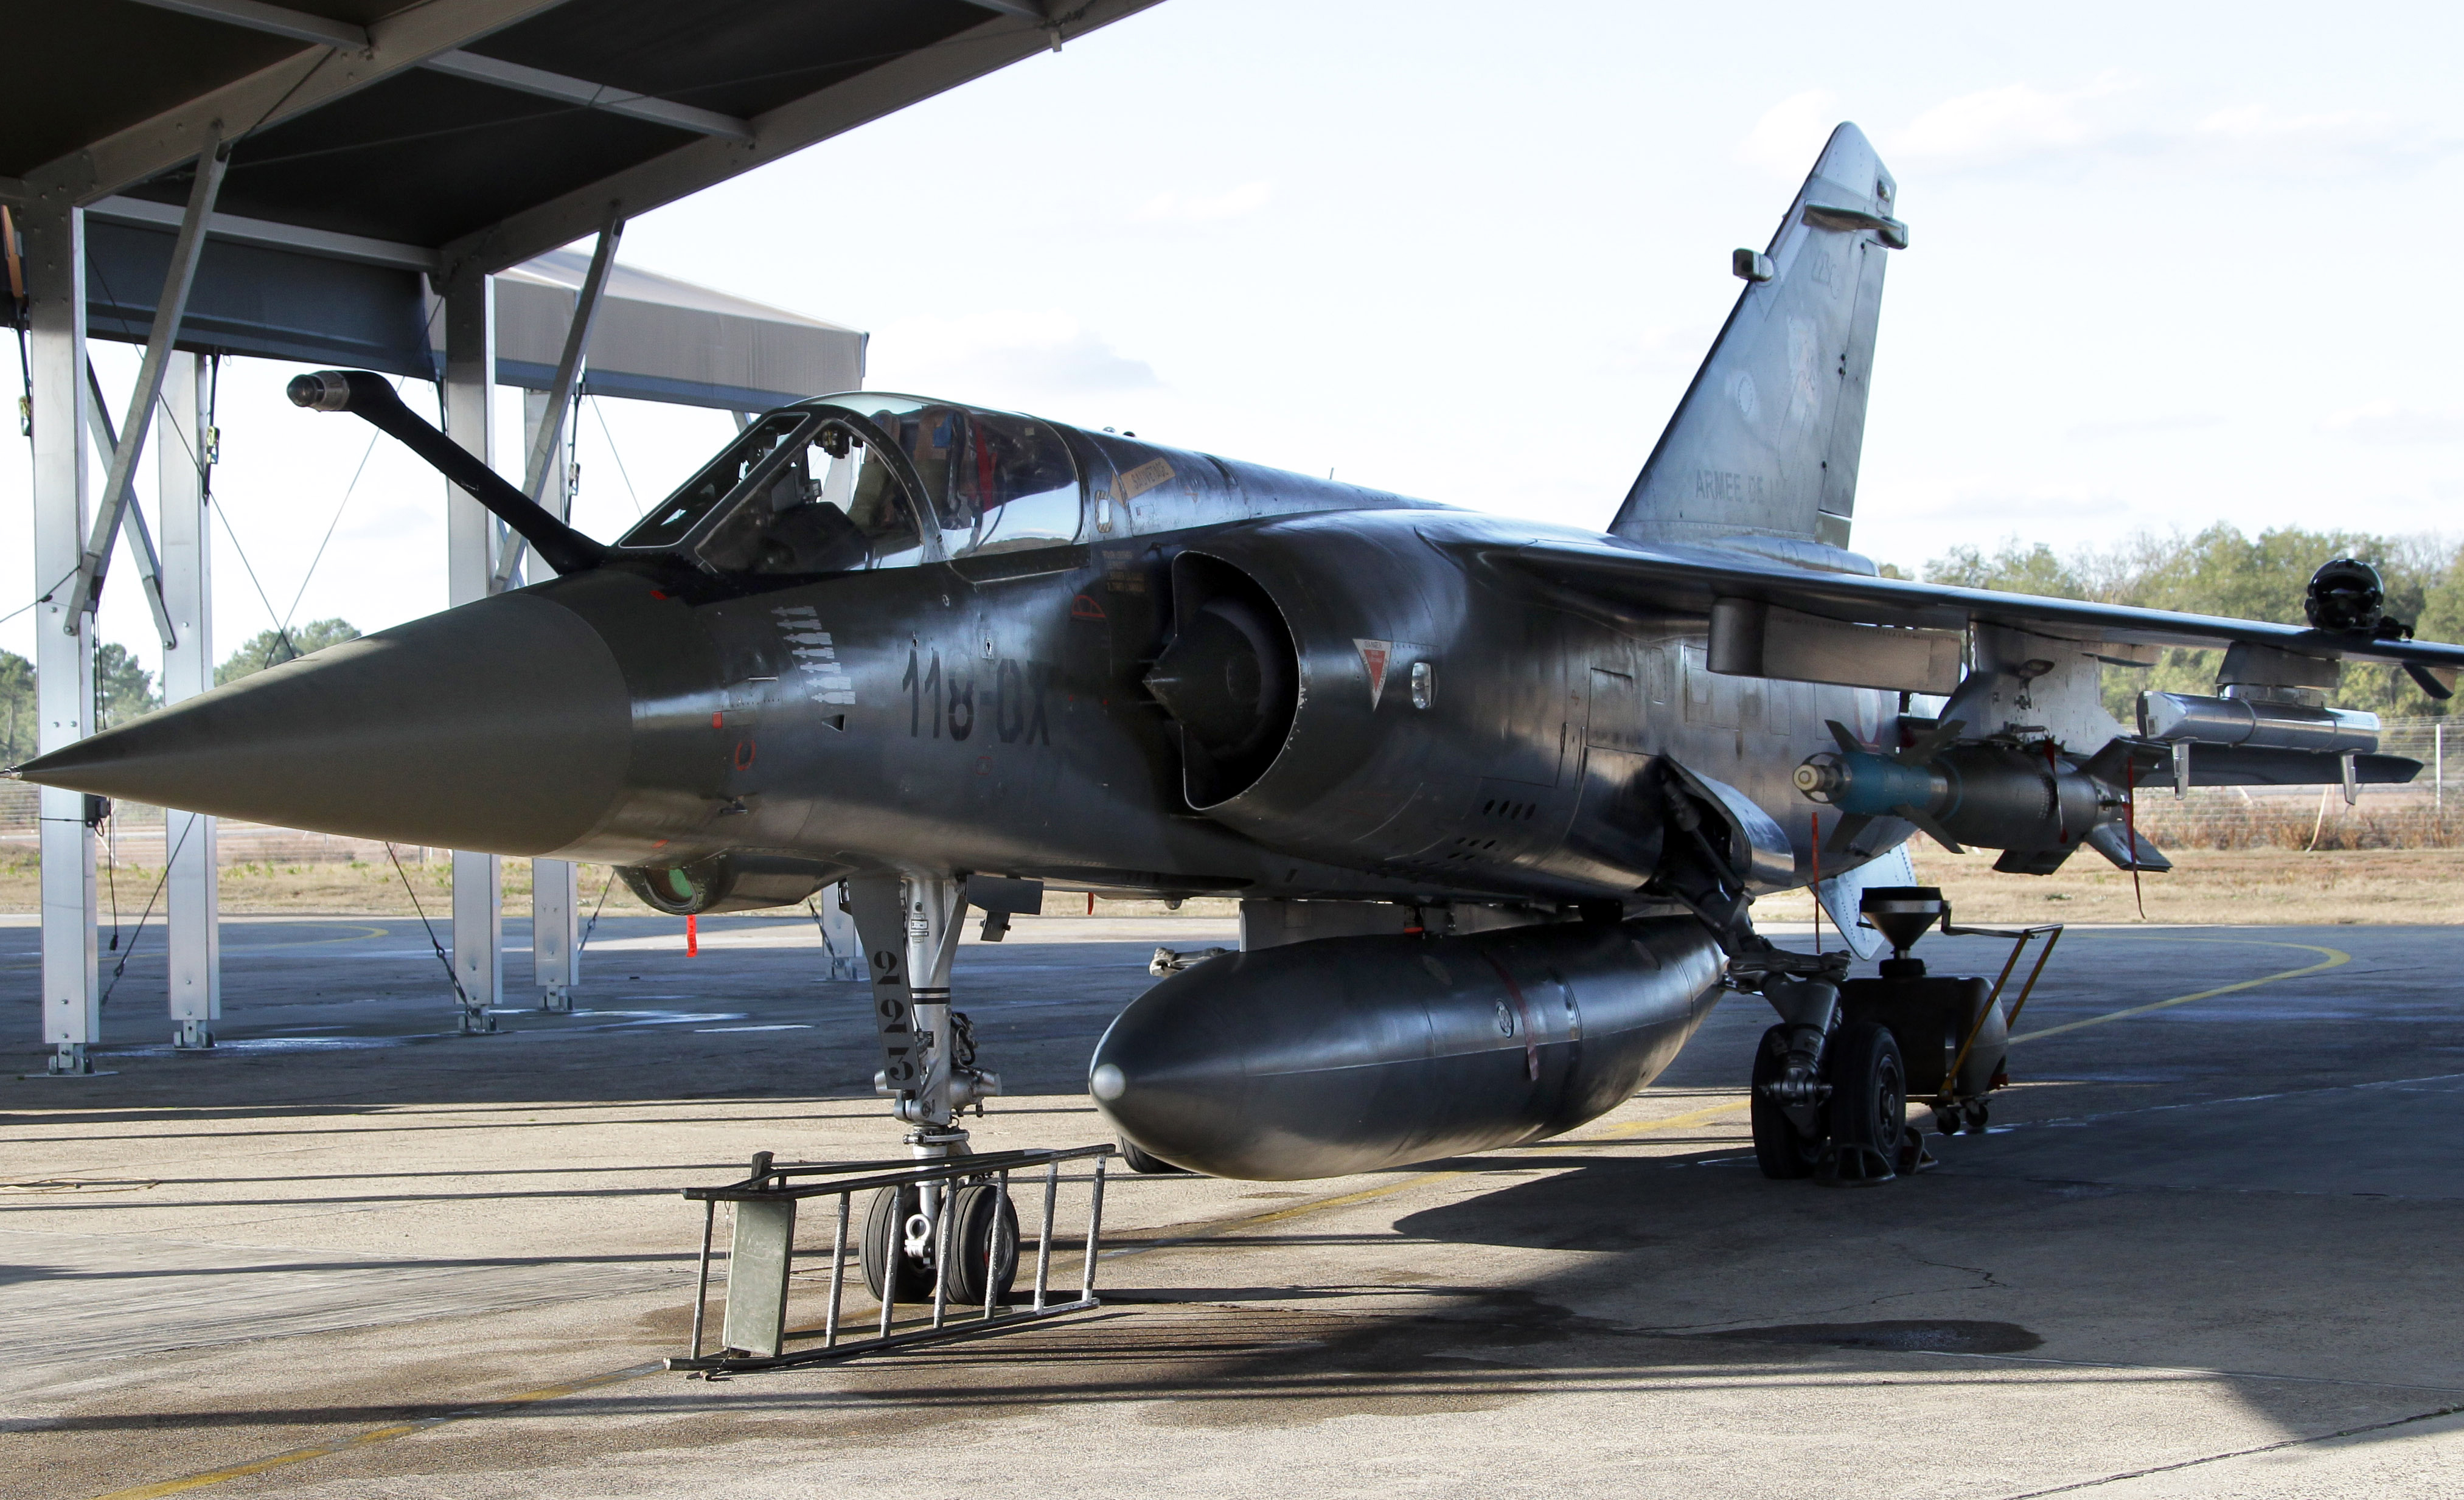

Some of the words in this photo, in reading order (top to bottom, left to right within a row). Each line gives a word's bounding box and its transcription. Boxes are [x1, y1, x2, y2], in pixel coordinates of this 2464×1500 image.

[1131, 461, 1169, 490] SAUVETAGE
[1696, 468, 1743, 502] ARMEE
[1748, 474, 1764, 504] DE
[874, 951, 914, 1082] 223
